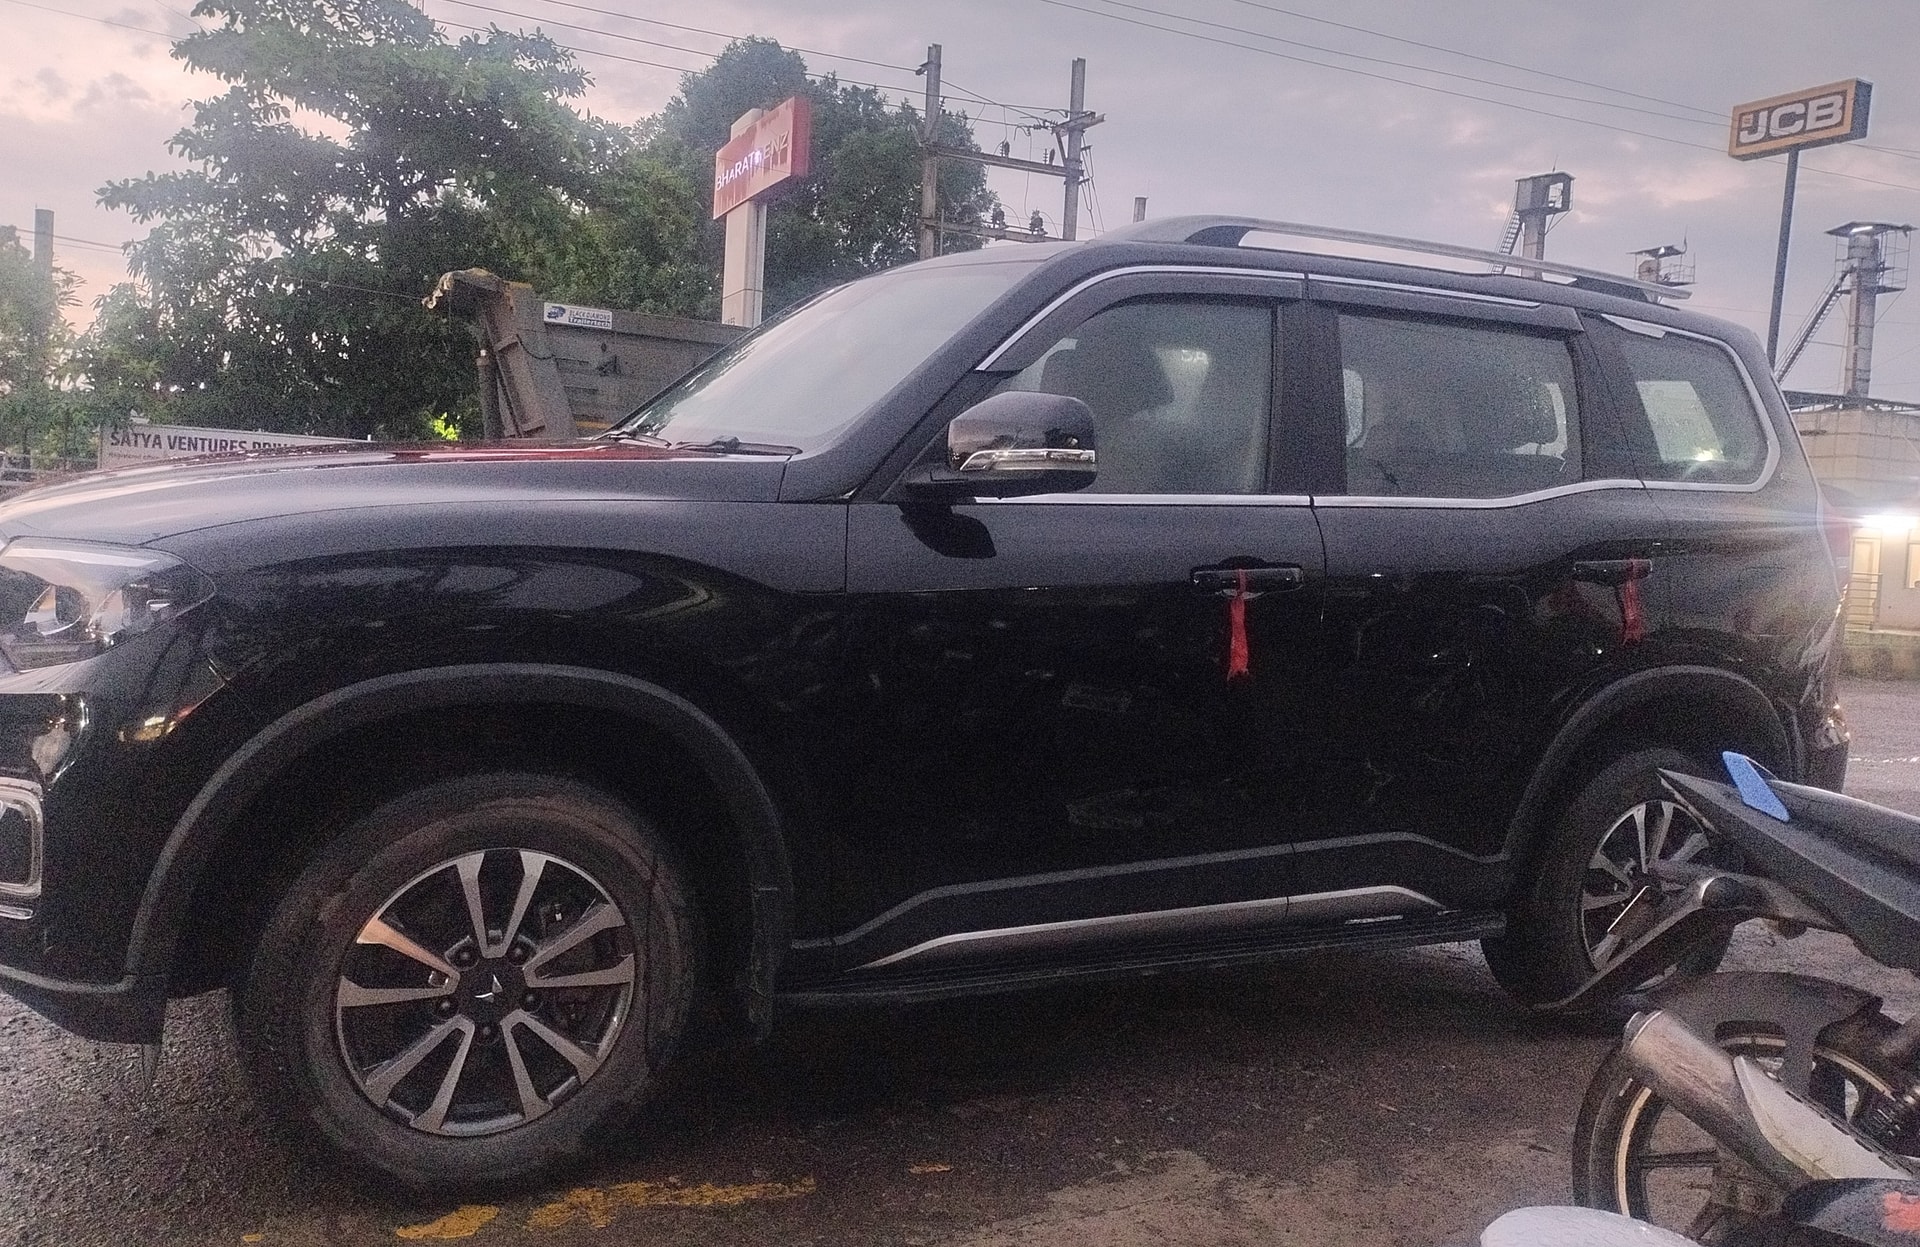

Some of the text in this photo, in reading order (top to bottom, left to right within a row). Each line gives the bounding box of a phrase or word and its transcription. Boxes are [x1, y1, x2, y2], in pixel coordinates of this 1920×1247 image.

[1739, 94, 1843, 144] JCB
[110, 431, 162, 449] SATYA
[167, 435, 247, 453] VENTURES
